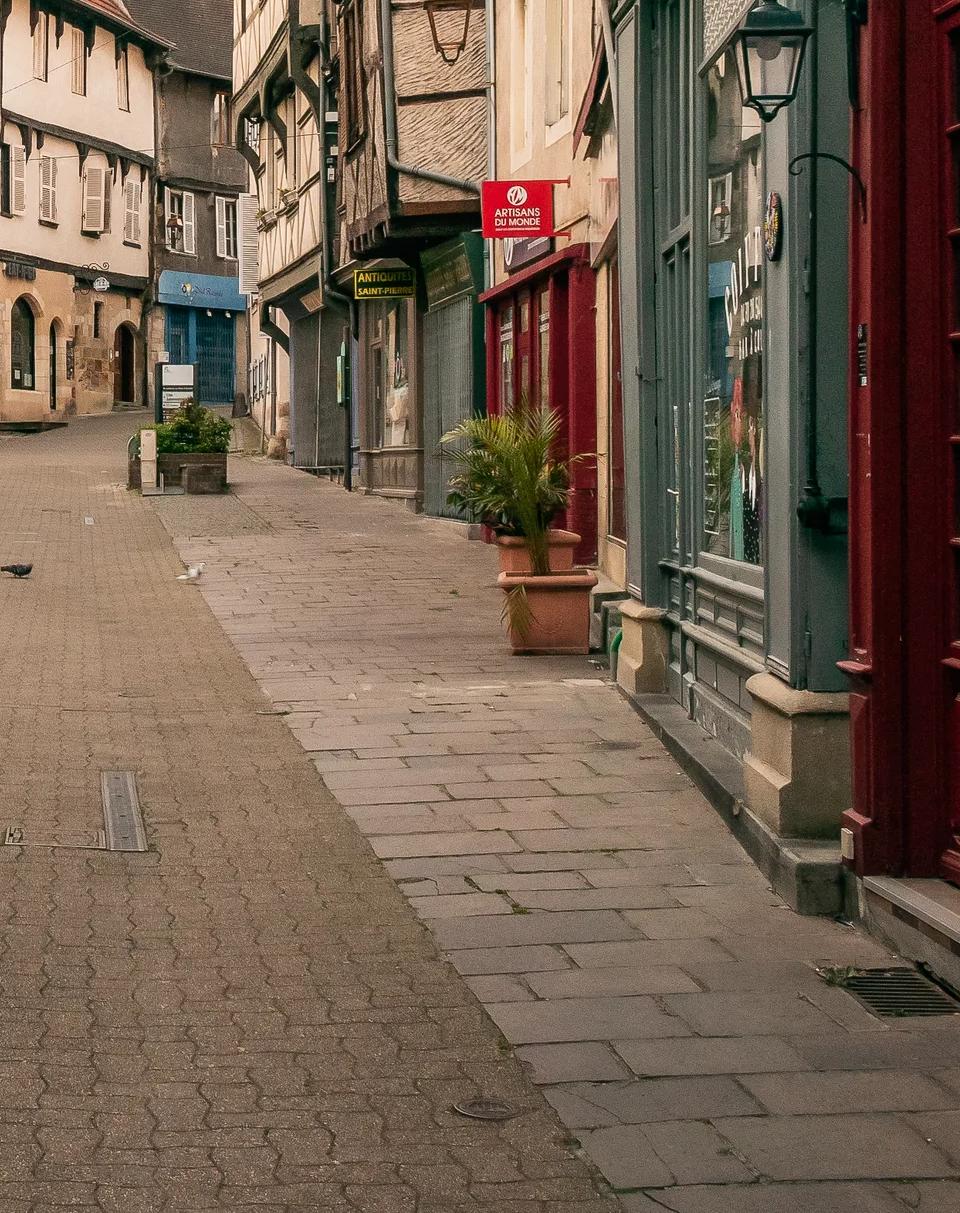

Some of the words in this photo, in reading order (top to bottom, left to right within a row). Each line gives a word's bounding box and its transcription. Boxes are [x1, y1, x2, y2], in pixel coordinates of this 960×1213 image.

[494, 207, 540, 217] ARTISANS
[494, 218, 506, 226] DU
[508, 217, 541, 226] MONDE
[357, 287, 413, 296] SAINT-PIERRE
